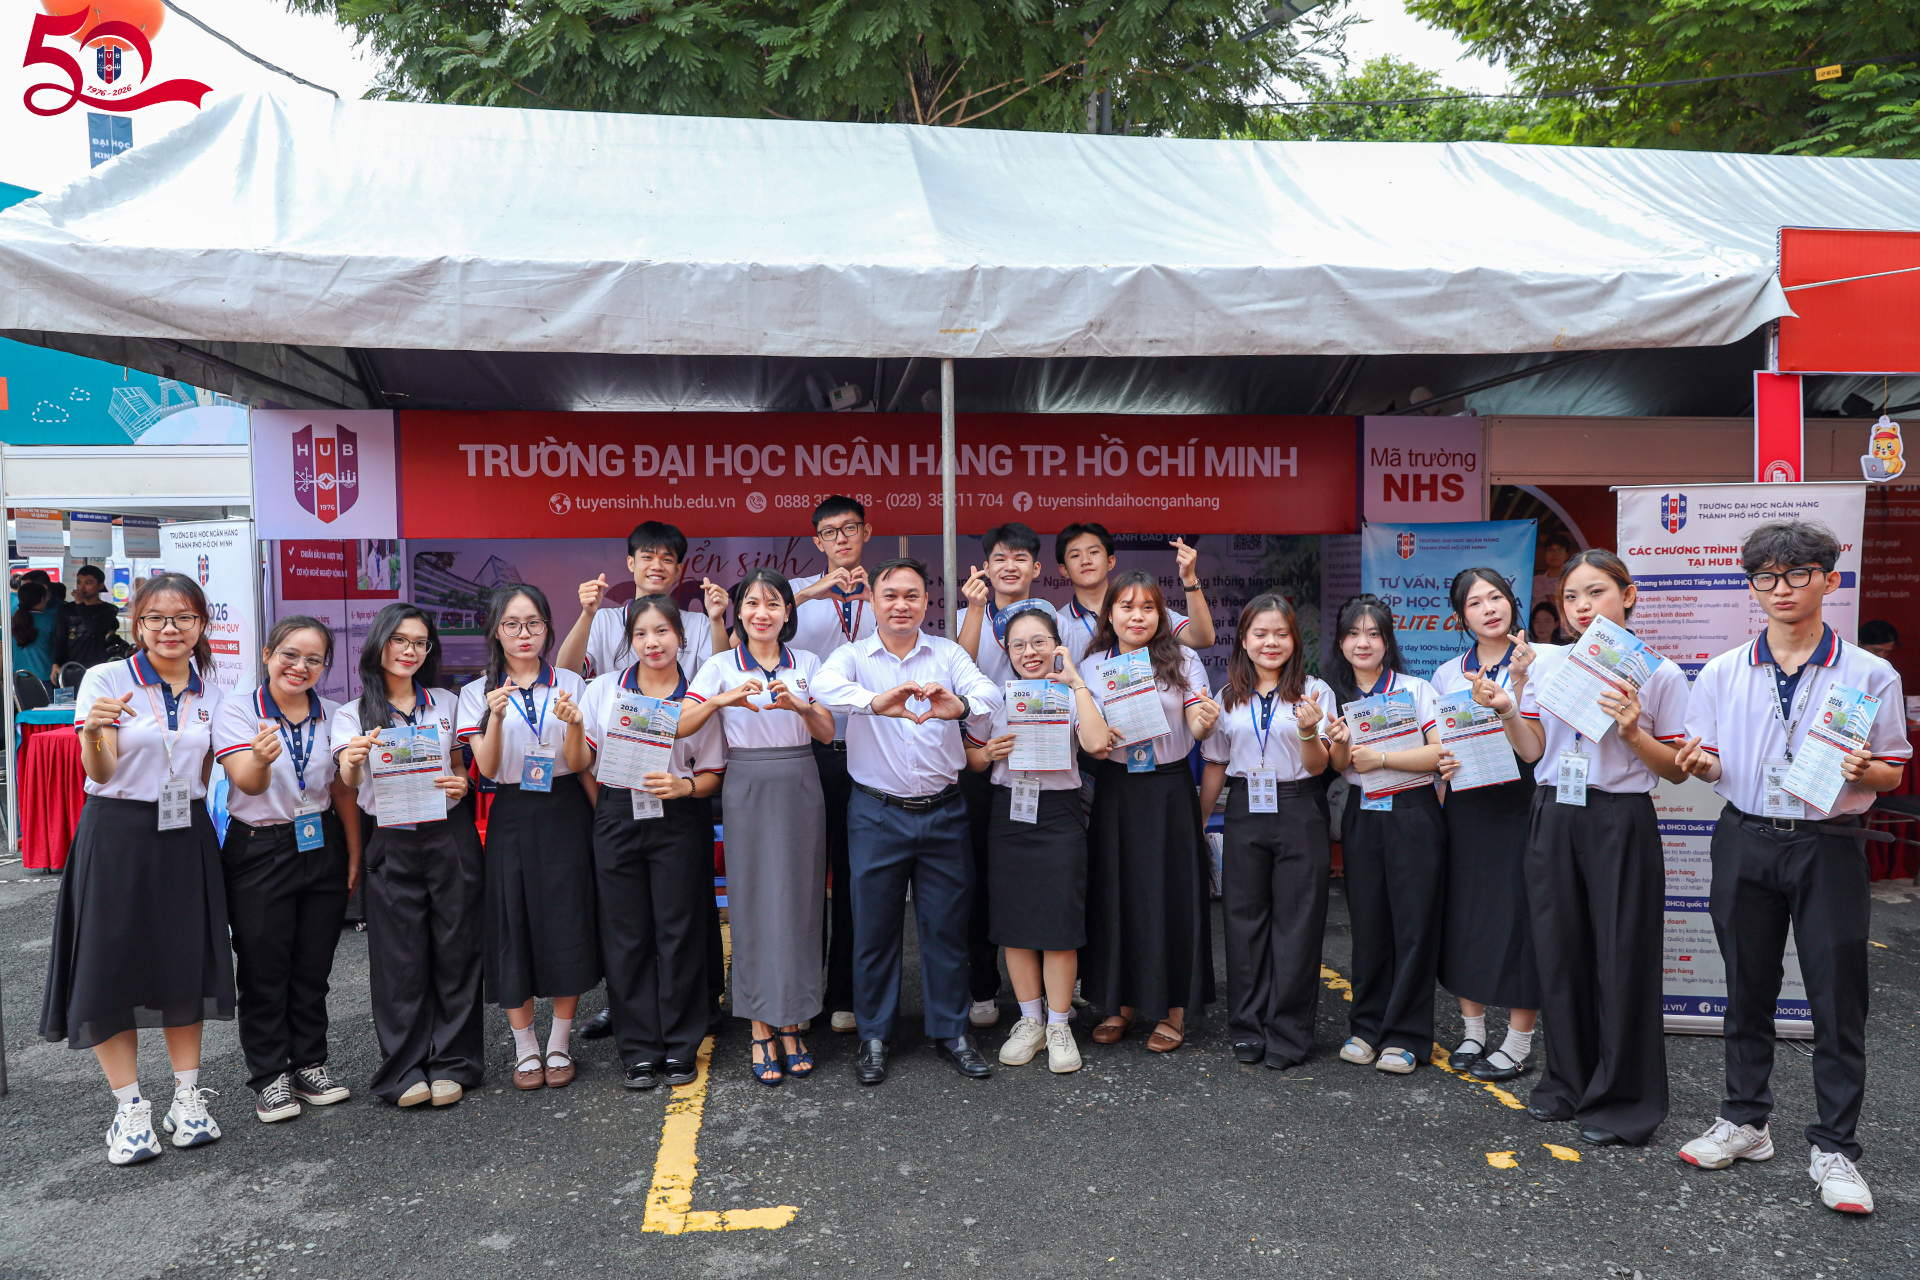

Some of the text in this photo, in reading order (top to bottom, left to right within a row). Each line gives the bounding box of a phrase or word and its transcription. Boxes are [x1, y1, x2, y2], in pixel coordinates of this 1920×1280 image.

[92, 138, 131, 150] ĐẠI HỌC
[296, 444, 354, 456] HUB
[459, 436, 625, 477] TRƯỜNG
[632, 444, 695, 484] ĐẠI
[706, 444, 785, 483] HỌC
[795, 436, 899, 476] NGÂN
[1020, 445, 1066, 476] TP.
[1077, 434, 1128, 477] HỒ
[1137, 438, 1199, 477] CHÍ
[1205, 446, 1298, 477] MINH
[1371, 448, 1476, 472] Mã trường
[1383, 473, 1465, 502] NHS
[575, 494, 736, 511] tuyensinh.hub.edu.vn
[774, 494, 810, 508] 0888
[886, 493, 922, 511] (028)
[977, 493, 1004, 507] 704
[1038, 493, 1220, 511] tuyensinhdaihocnganhang
[1698, 502, 1732, 510] TRƯỜNG
[1750, 502, 1768, 510] HỌC
[1728, 511, 1745, 519] PHỐ
[1629, 545, 1652, 555] CÁC
[1654, 545, 1700, 555] CHƯƠNG
[1703, 544, 1738, 554] TRÌNH
[1688, 558, 1705, 568] TẠI
[1708, 558, 1733, 566] HUB
[1159, 576, 1173, 589] Hệ
[1216, 576, 1245, 589] thông
[1249, 576, 1265, 587] tin
[1379, 576, 1401, 588] TƯ
[1403, 574, 1440, 590] VẤN,
[1634, 580, 1658, 588] Chương
[1694, 578, 1711, 587] Tiếng
[1167, 596, 1187, 609] ông
[1382, 593, 1402, 608] ỚP
[1406, 596, 1441, 610] HỌC
[208, 603, 228, 621] 026
[1636, 611, 1651, 619] Quản
[1392, 614, 1440, 632] ELITE
[226, 624, 239, 633] QUY
[1595, 631, 1615, 646] 2026
[227, 643, 238, 651] NHS
[1657, 643, 1671, 651] quốc
[1102, 669, 1117, 677] 2026
[1828, 697, 1843, 708] 2026
[620, 704, 638, 712] 2026
[1440, 706, 1457, 714] 2026
[1353, 710, 1371, 718] 2026
[1686, 900, 1702, 908] quốc
[1678, 967, 1694, 975] hàng
[1663, 1003, 1687, 1011] u.vn/
